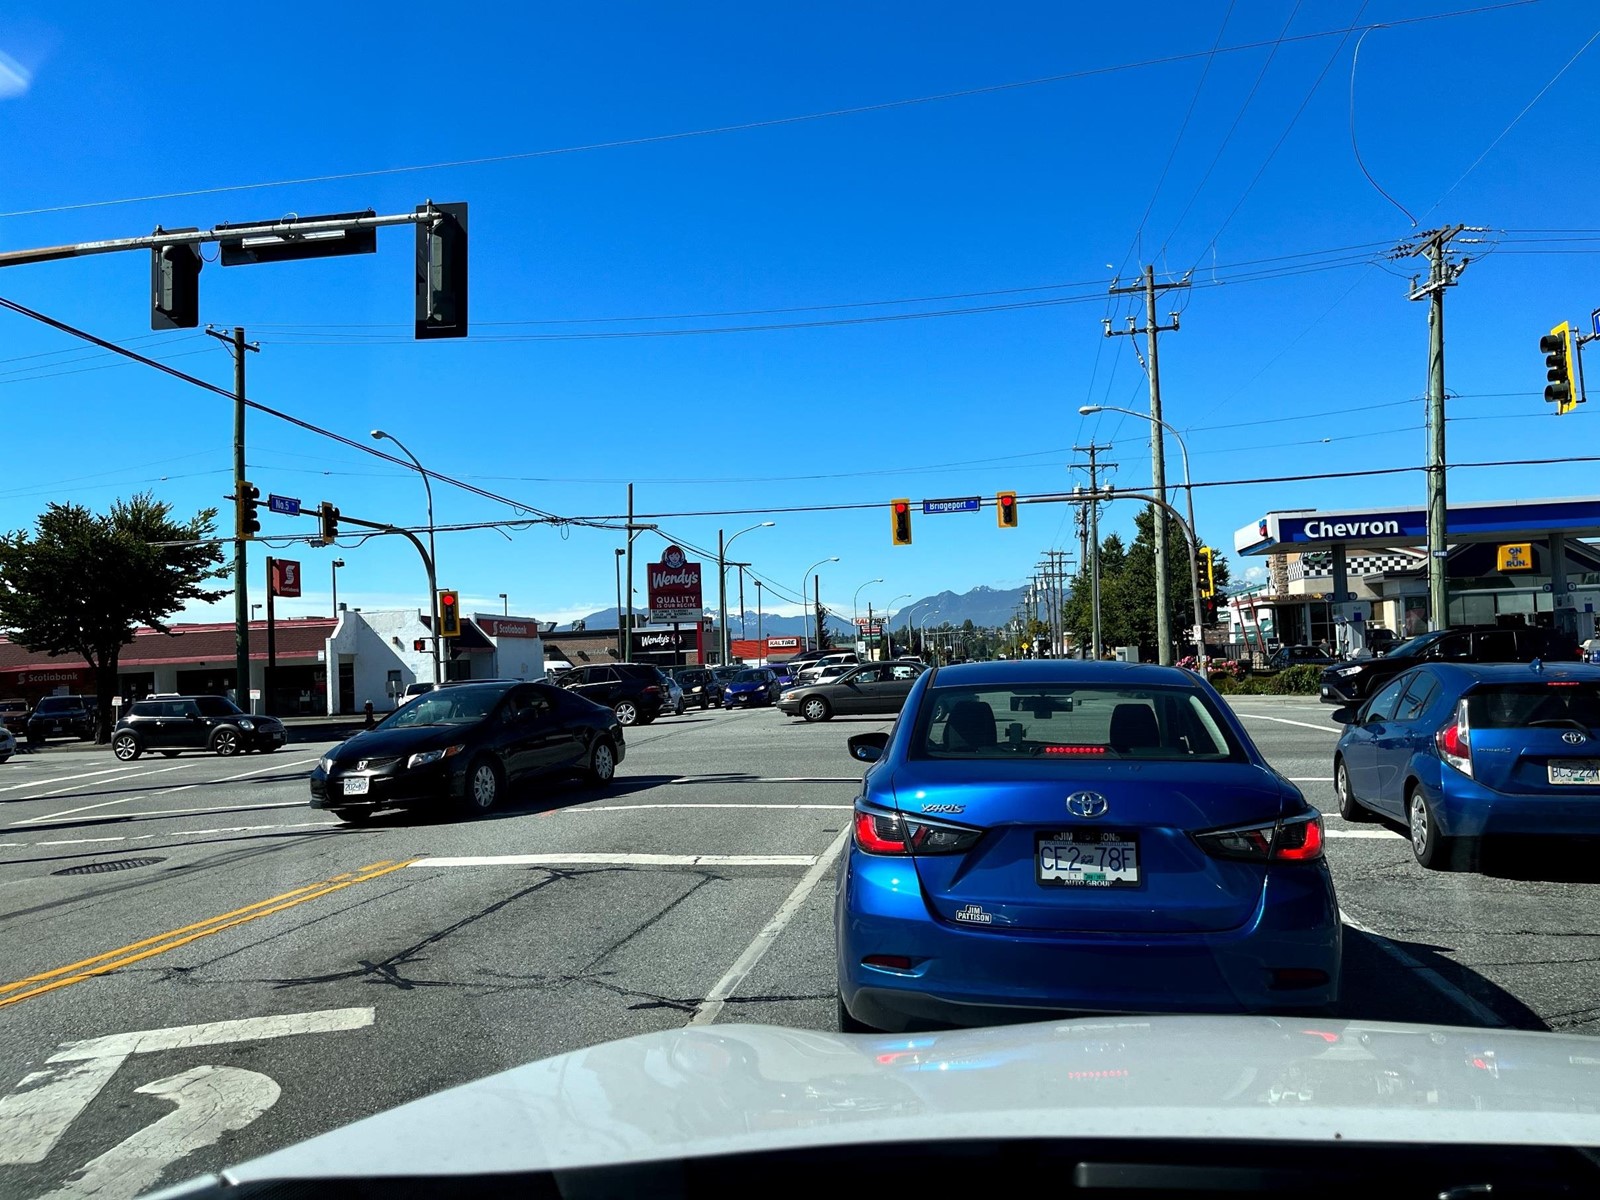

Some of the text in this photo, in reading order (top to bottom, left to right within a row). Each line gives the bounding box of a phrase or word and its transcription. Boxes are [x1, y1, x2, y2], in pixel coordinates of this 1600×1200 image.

[929, 501, 967, 511] Bridgeport
[1304, 520, 1399, 538] Chevron
[1508, 547, 1522, 555] ON
[652, 569, 699, 589] Wendy's
[656, 596, 696, 604] QUALITY
[499, 623, 528, 635] Scotiabank
[641, 633, 670, 647] Wendy's
[28, 672, 78, 682] Scotiabank
[921, 803, 965, 814] YARIS
[1058, 832, 1073, 841] JIM
[1041, 846, 1135, 872] CE2 78F
[957, 913, 990, 922] PATTISON
